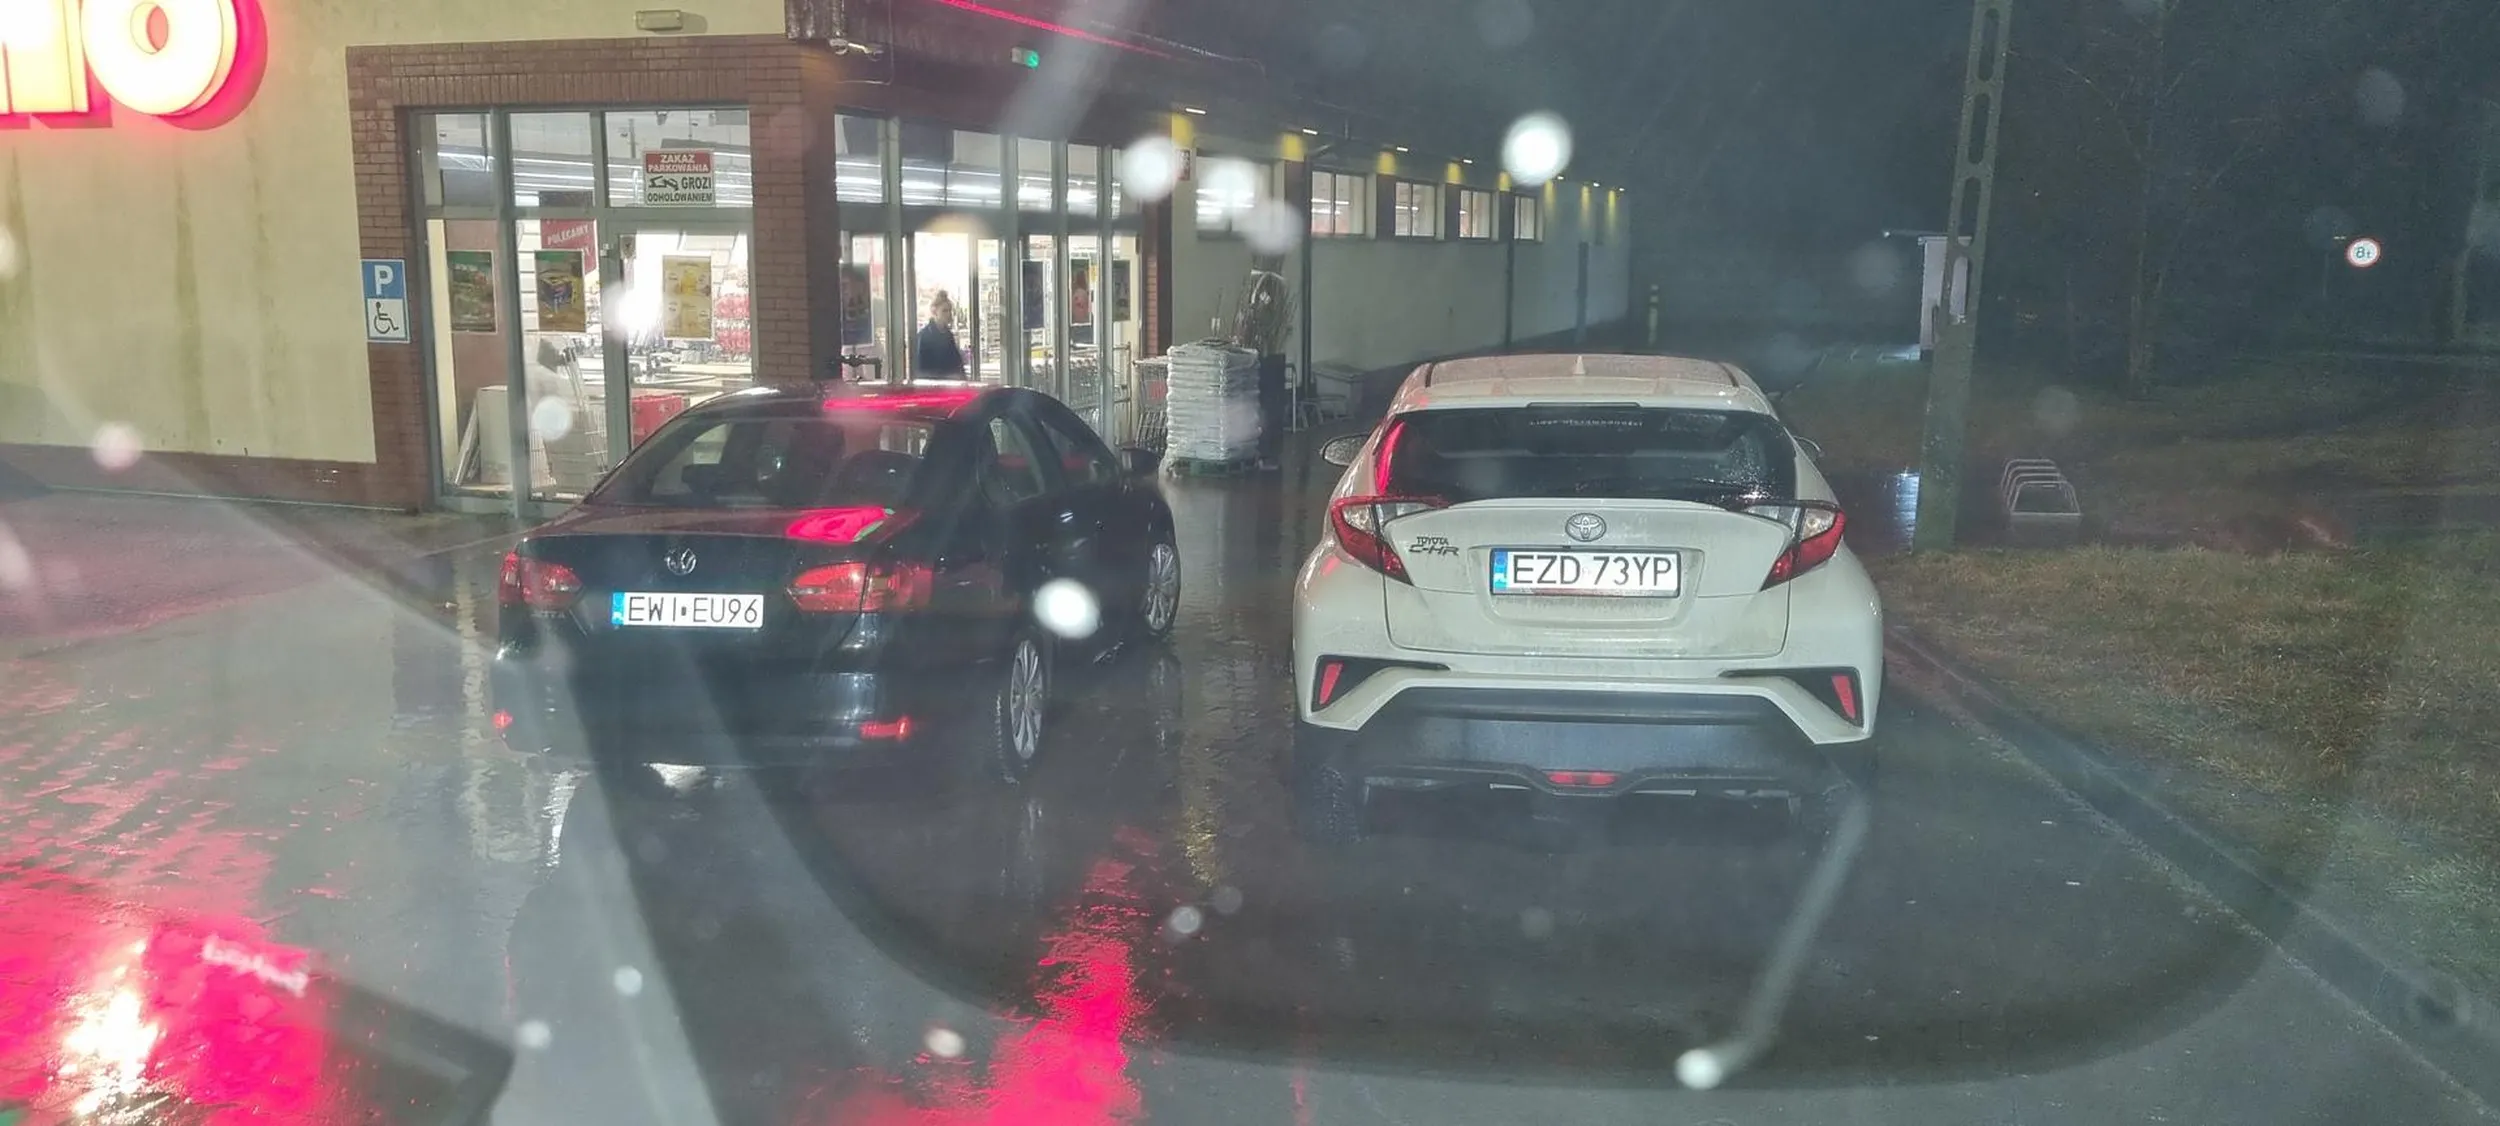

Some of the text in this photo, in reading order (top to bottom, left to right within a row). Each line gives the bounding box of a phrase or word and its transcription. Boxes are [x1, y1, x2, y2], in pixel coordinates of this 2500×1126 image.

[660, 154, 696, 164] ZAKAZ
[648, 164, 709, 173] PARKOWANIA
[681, 176, 712, 190] GROZI
[647, 192, 713, 202] ODHOLOWANIEM
[374, 264, 394, 296] P
[1416, 536, 1449, 546] TOYOTA
[1409, 544, 1460, 557] C-HR
[1513, 554, 1672, 587] EZD 73YP
[628, 596, 758, 624] EWI EU96
